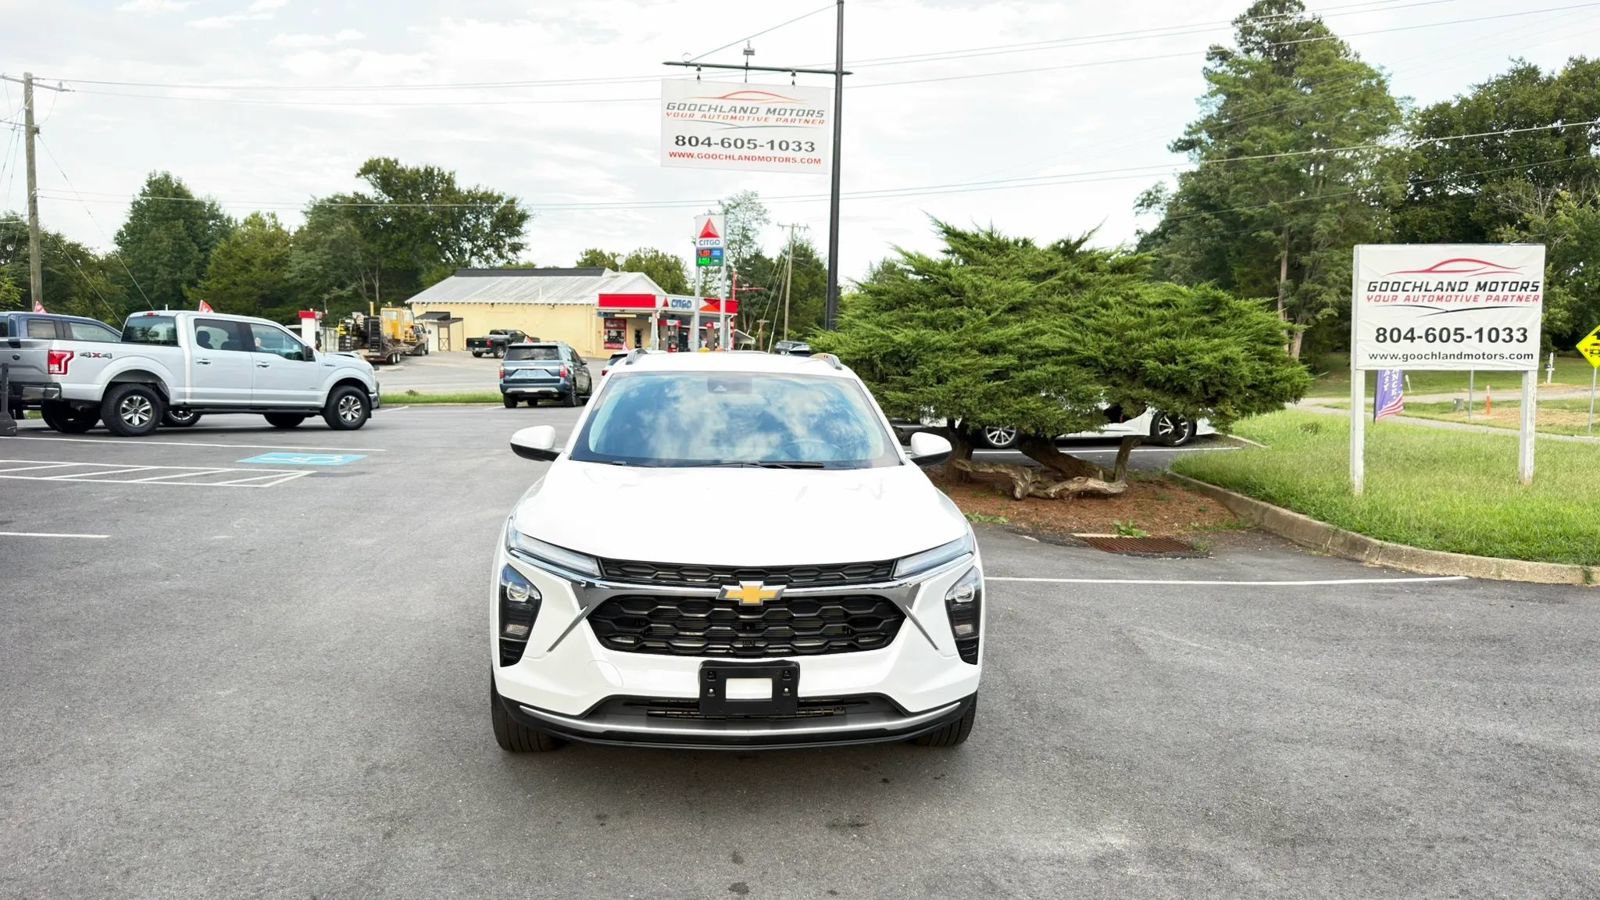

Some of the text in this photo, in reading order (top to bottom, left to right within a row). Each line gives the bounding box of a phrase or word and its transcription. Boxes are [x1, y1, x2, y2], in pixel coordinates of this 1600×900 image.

[666, 102, 825, 118] GOOCHLAND MOTORS
[701, 113, 770, 122] AUTOMOTIVE
[776, 117, 825, 125] PARTNER
[674, 135, 816, 153] 804-605-1033
[668, 151, 822, 165] WWW.GOOCHLANDMOTORS.COM
[1367, 281, 1540, 292] GOOCHLAND MOTORS
[671, 298, 692, 309] CITGO
[1366, 294, 1540, 303] YOUR AUTOMOTIVE PARTNER
[1375, 326, 1528, 344] 804-605-1033
[1368, 351, 1534, 363] www.goochlandmotors.com
